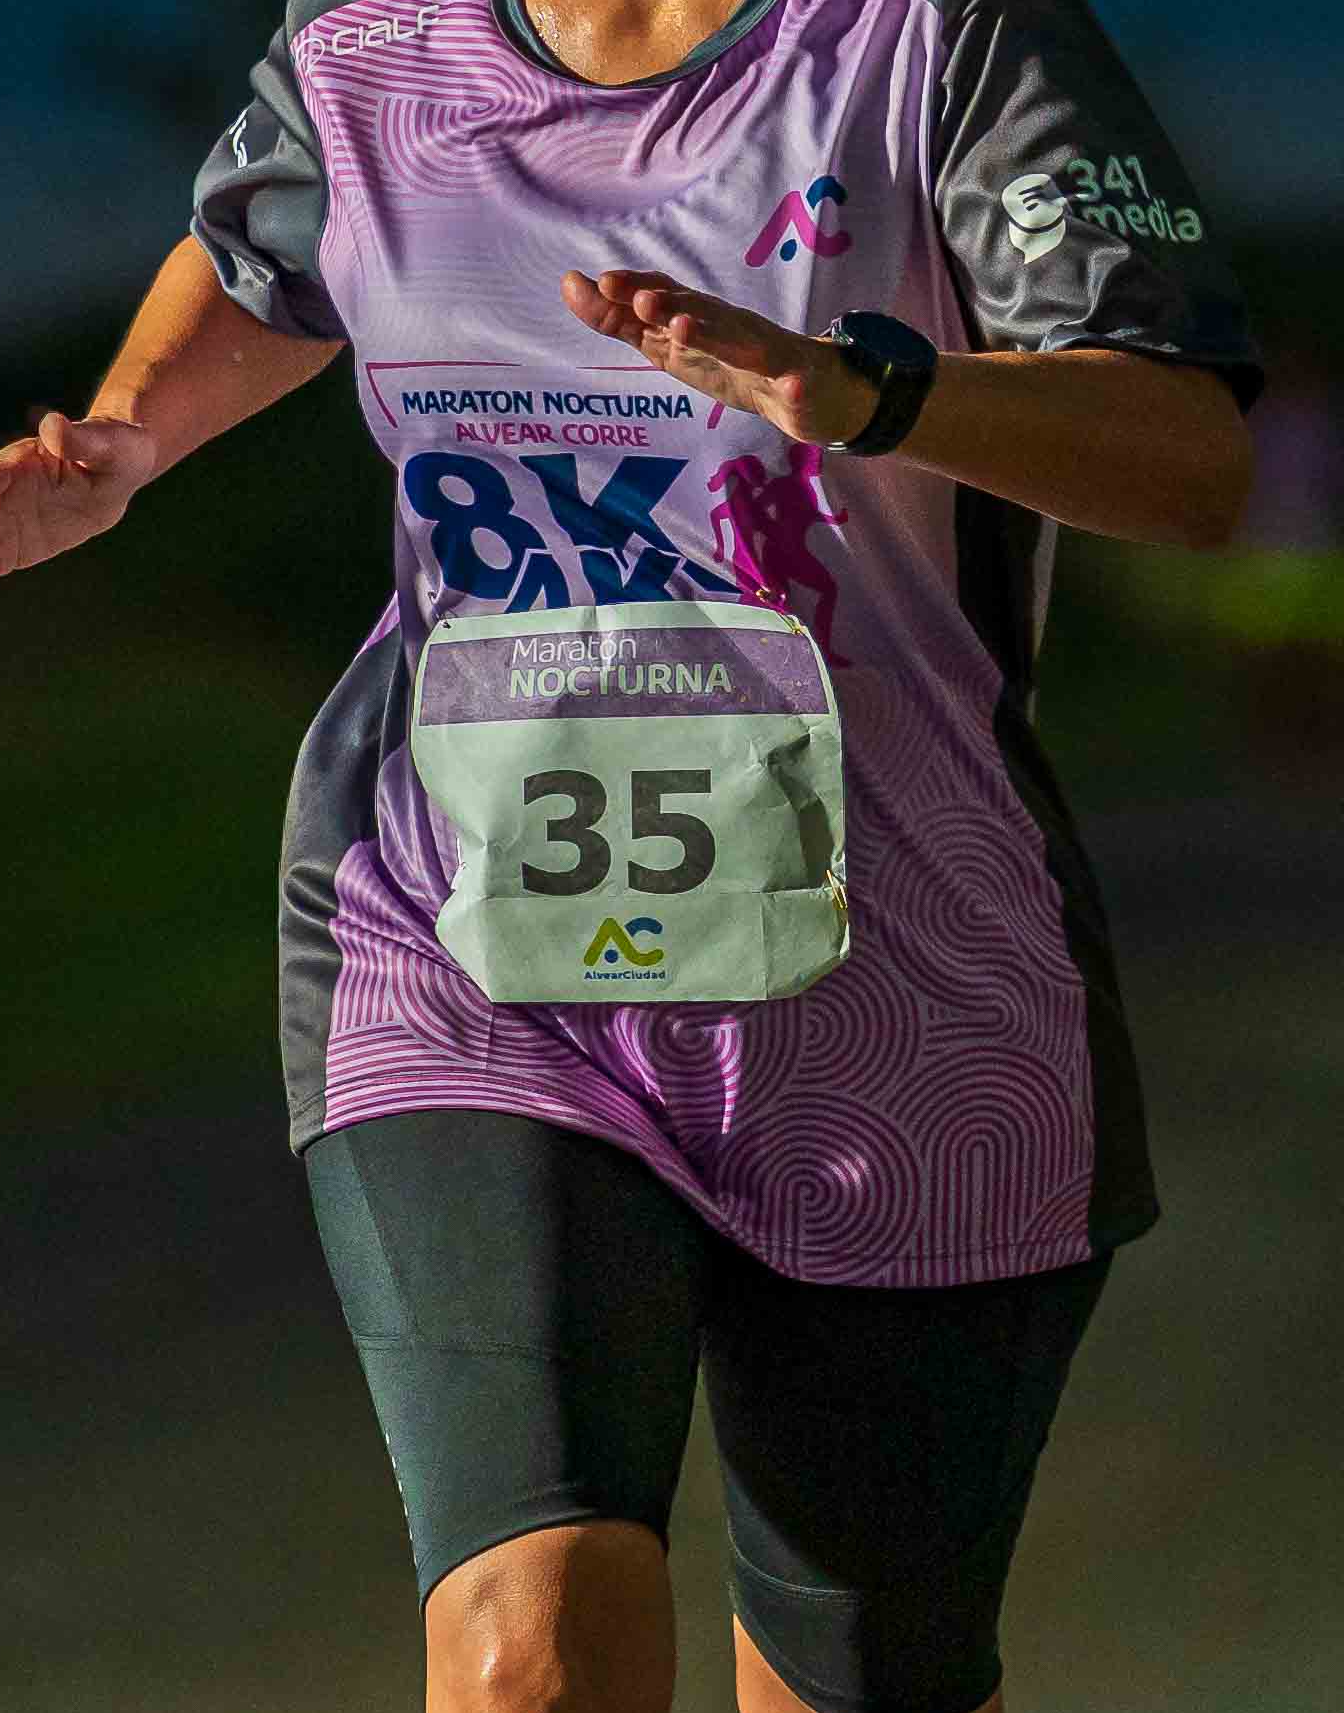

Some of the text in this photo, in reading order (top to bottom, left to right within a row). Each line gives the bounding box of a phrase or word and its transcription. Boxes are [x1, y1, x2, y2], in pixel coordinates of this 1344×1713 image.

[1067, 154, 1151, 202] 341
[1082, 197, 1203, 244] media
[402, 389, 694, 419] MARATON NOCTURNA
[456, 422, 651, 447] ALVEAR CORRE
[404, 451, 742, 600] 8K
[511, 631, 637, 664] Maratón
[509, 662, 733, 699] NOCTURNA
[521, 769, 717, 896] 35
[583, 970, 666, 980] AlvearCiudad
